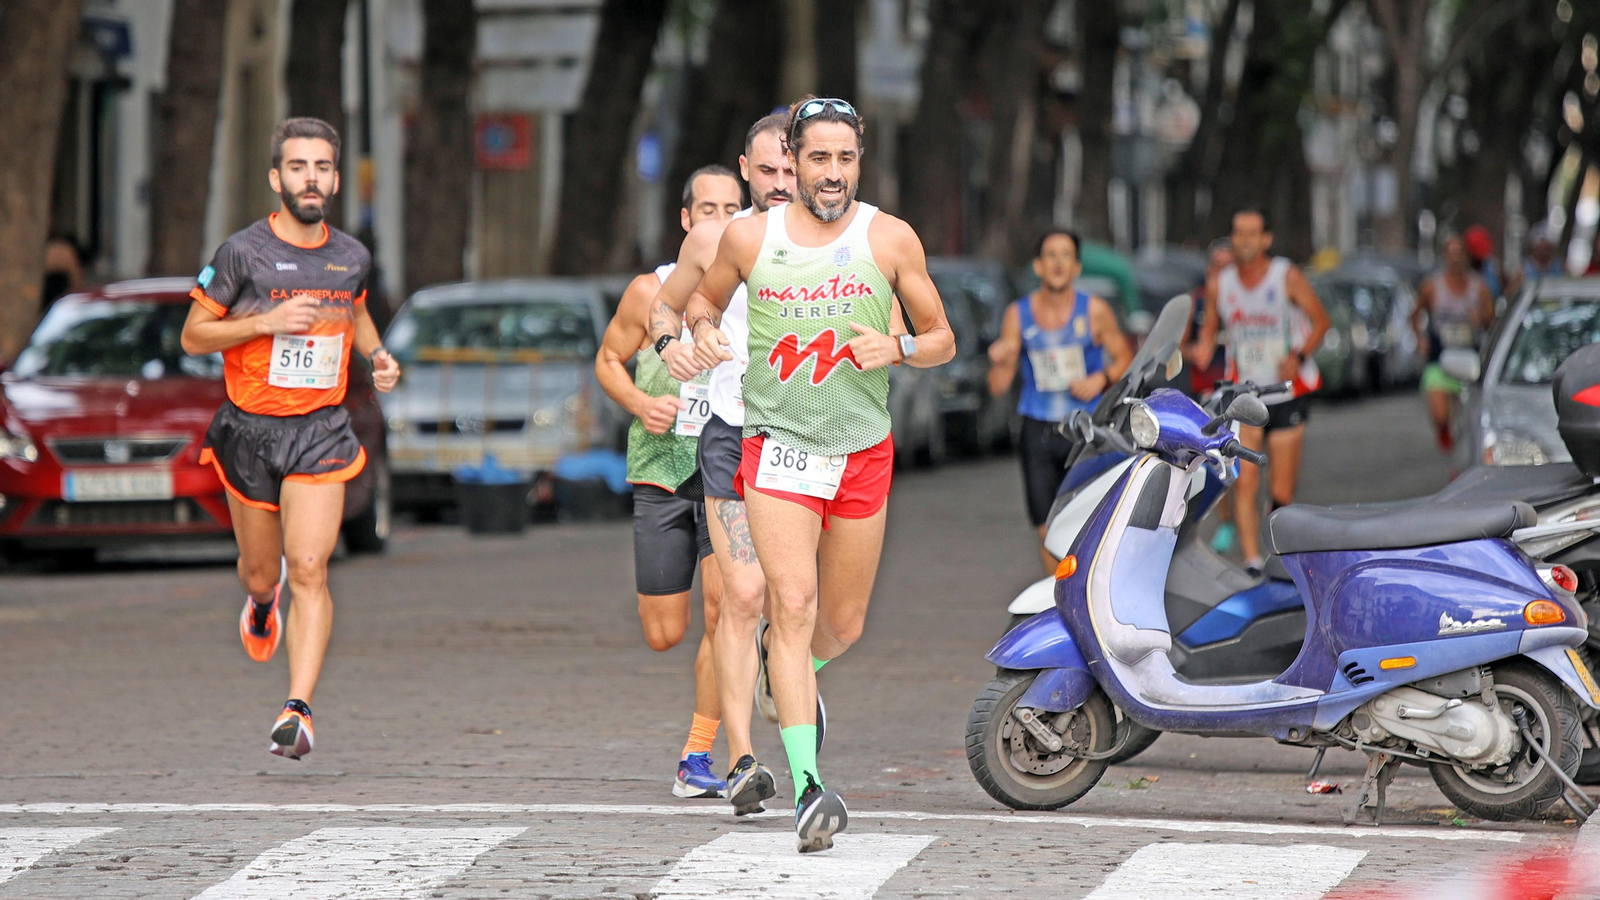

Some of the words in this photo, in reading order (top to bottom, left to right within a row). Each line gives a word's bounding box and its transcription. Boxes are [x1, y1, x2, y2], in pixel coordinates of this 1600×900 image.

[270, 288, 290, 299] C.A.
[291, 288, 352, 299] CORREPLAYAS
[758, 274, 872, 301] maratón
[779, 303, 852, 318] JEREZ
[279, 349, 314, 368] 516
[687, 398, 710, 417] 70
[770, 446, 808, 472] 368
